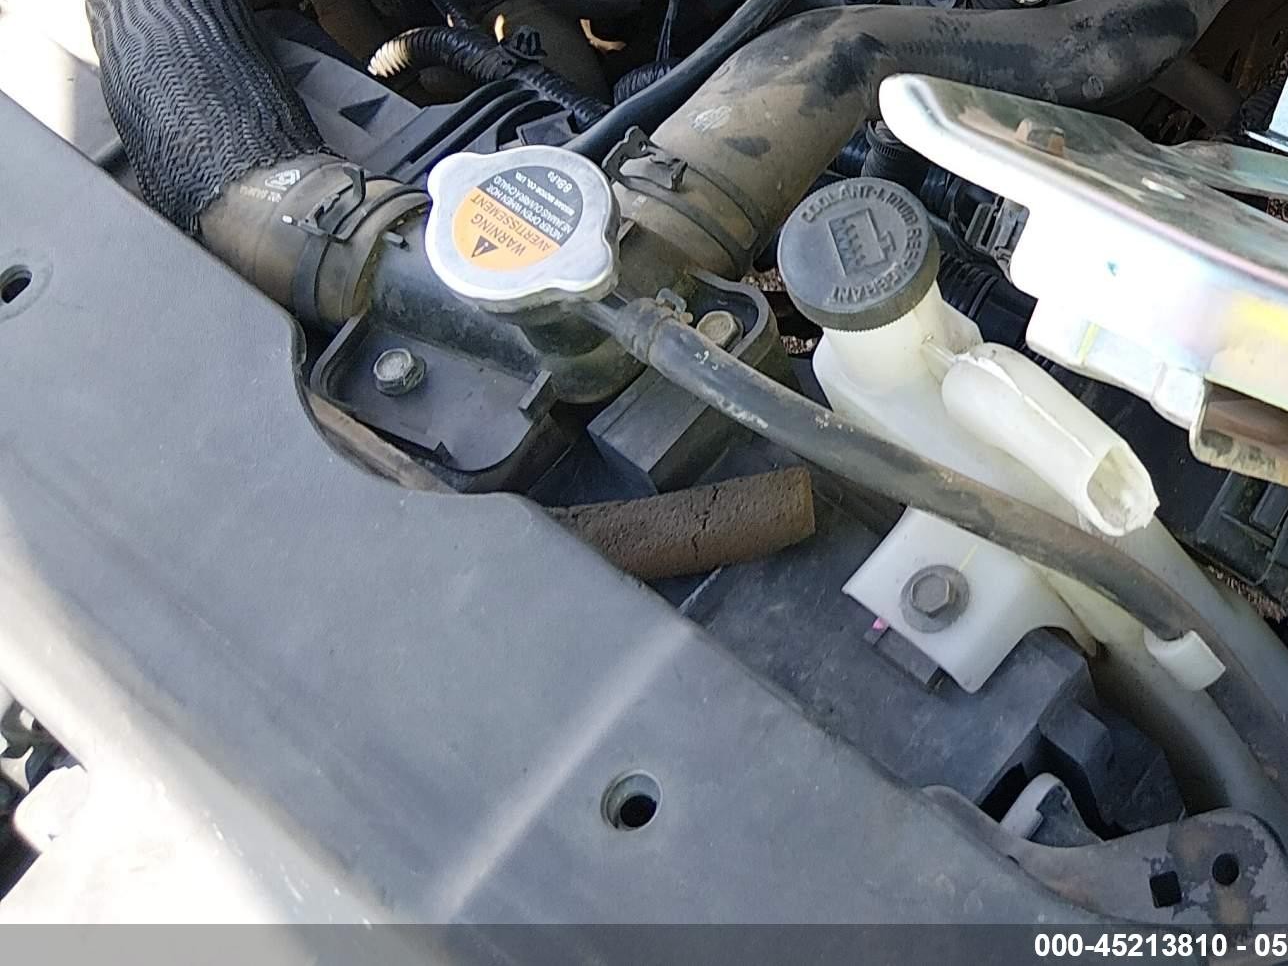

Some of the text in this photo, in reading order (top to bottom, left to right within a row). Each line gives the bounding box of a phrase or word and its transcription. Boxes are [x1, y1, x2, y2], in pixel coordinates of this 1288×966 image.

[470, 194, 552, 252] AVERTISSEMENT
[520, 208, 541, 225] OPEN
[540, 208, 562, 228] JAMAIS
[470, 212, 526, 257] WARNING
[539, 220, 564, 240] NEVER
[560, 221, 574, 234] NE
